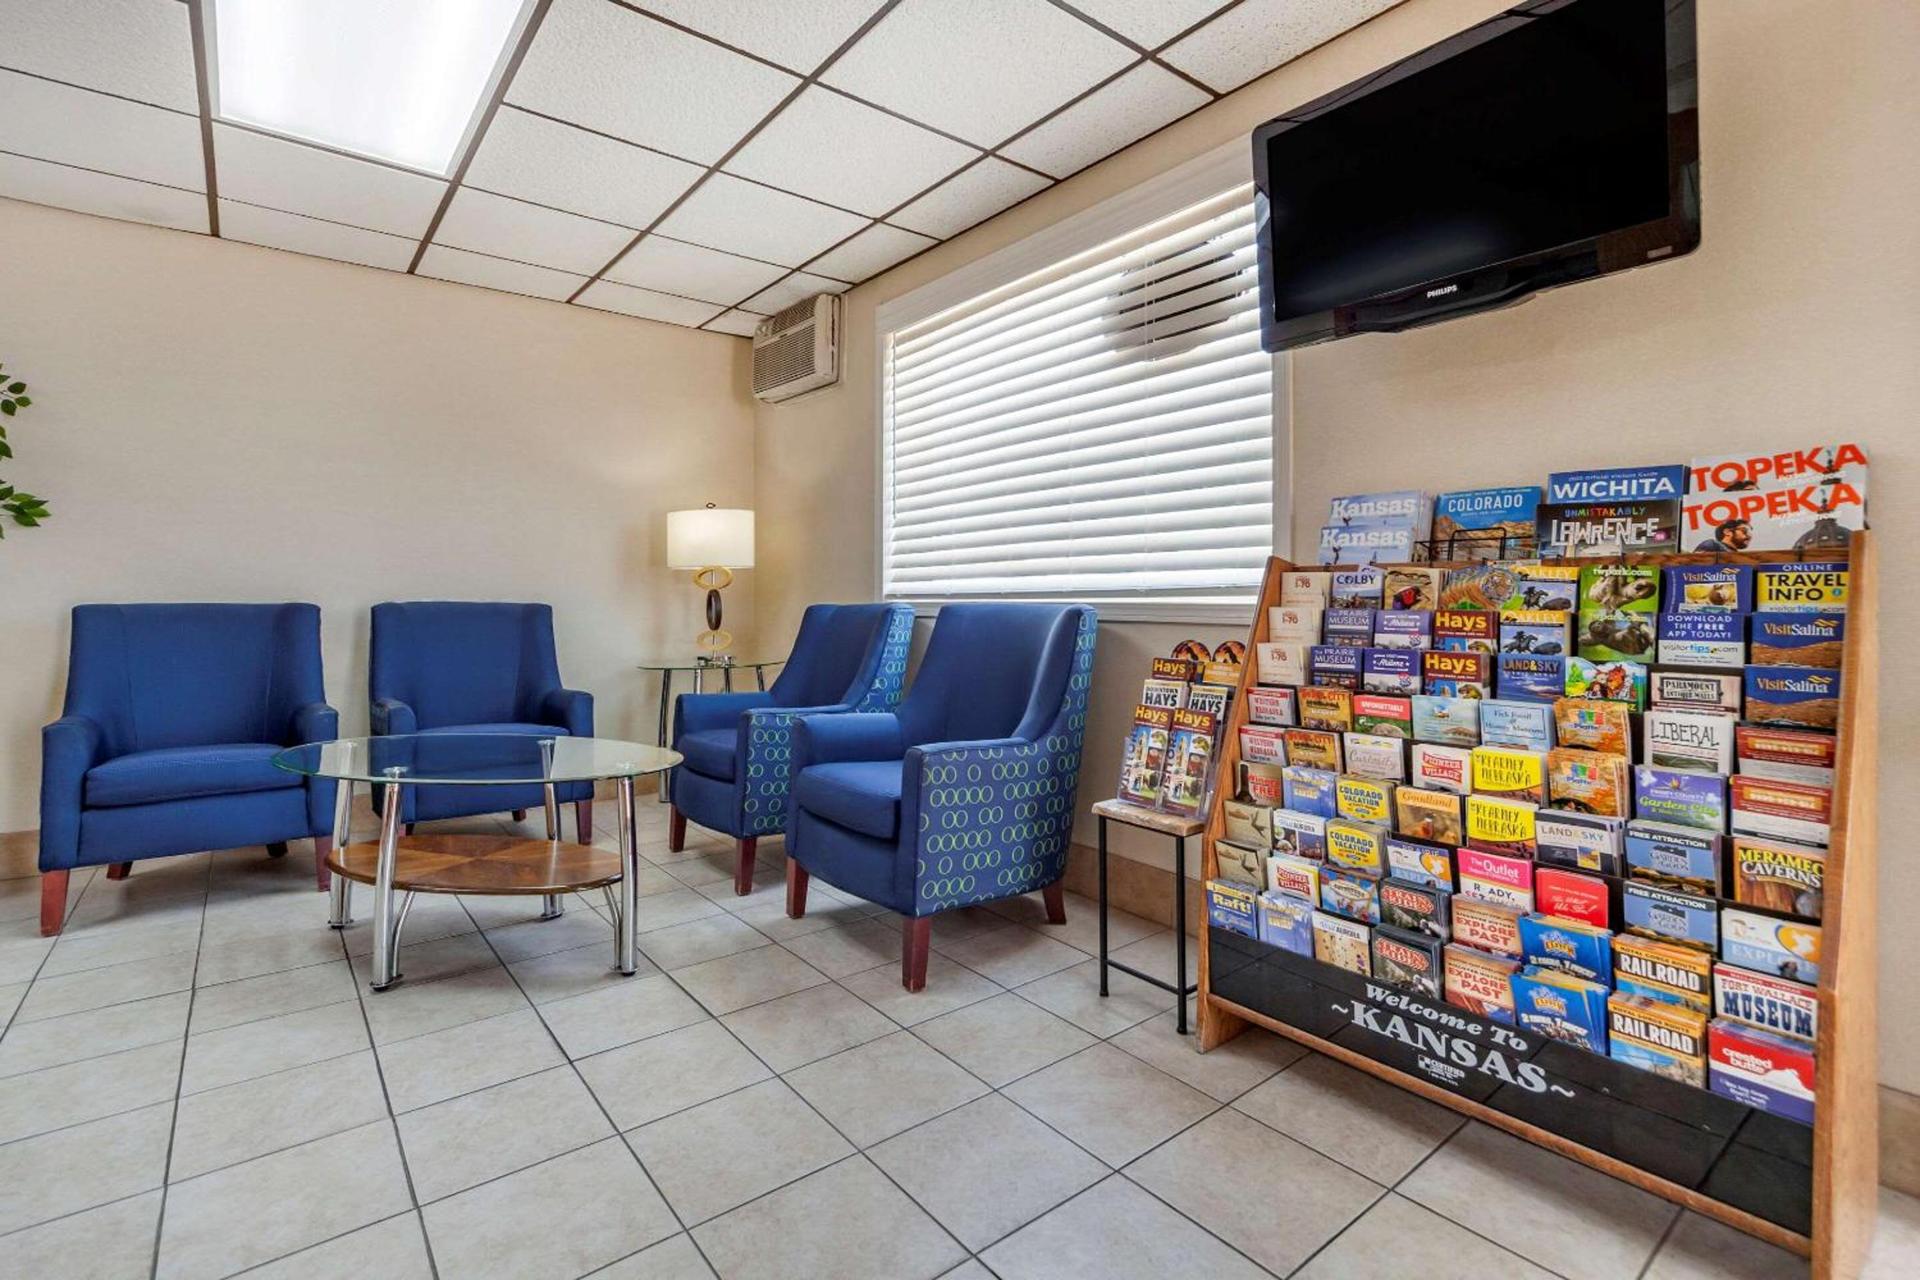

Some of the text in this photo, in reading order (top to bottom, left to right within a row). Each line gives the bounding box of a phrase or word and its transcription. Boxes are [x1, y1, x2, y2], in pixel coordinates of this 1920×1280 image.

[1427, 283, 1458, 299] PHILIPS
[1691, 443, 1868, 493] TOPEKA
[1553, 477, 1676, 499] WICHITA
[1332, 498, 1418, 519] Kansas
[1448, 494, 1524, 513] COLORADO
[1564, 506, 1647, 518] UNMISTAKABLY
[1683, 483, 1862, 530] TOPEKA
[1321, 528, 1409, 549] Kansas
[1551, 518, 1660, 546] LAWRENCE
[1782, 564, 1832, 572] ONLINE
[1336, 574, 1377, 585] COLBY
[1766, 573, 1846, 587] TRAVEL
[1768, 588, 1824, 601] INFO
[1328, 617, 1370, 626] MUSEUM
[1435, 612, 1488, 631] Hays
[1667, 615, 1733, 623] DOWNLOAD
[1697, 623, 1725, 631] FREE
[1667, 630, 1732, 638] APP TODAY!
[1153, 659, 1187, 675] Hays
[1314, 655, 1356, 664] MUSEUM
[1425, 653, 1477, 674] Hays
[1665, 681, 1715, 690] PARAMOUNT
[1144, 692, 1178, 707] HAYS
[1190, 699, 1223, 714] HAYS
[1135, 706, 1169, 723] Hays
[1174, 709, 1211, 727] Hays
[1651, 719, 1720, 747] LIBERAL
[1481, 754, 1524, 770] KEARNEY
[1482, 768, 1531, 786] NEBRASKA
[1339, 786, 1383, 800] COLORADO
[1343, 795, 1380, 807] VACATION
[1475, 803, 1519, 820] KEARNEY
[1640, 796, 1687, 811] Garden
[1476, 817, 1526, 838] NEBRASKA
[1541, 826, 1573, 836] LAND
[1581, 830, 1604, 841] SKY
[1330, 832, 1373, 847] COLORADO
[1334, 841, 1370, 854] VACATION
[1629, 830, 1707, 848] FREE ATTRACTION
[1483, 859, 1519, 879] Outlet
[1739, 848, 1823, 878] MERAMEC
[1741, 861, 1822, 888] CAVERNS
[1213, 893, 1251, 914] Raft!
[1628, 887, 1706, 910] FREE ATTRACTION
[1456, 916, 1517, 938] EXPLORE
[1470, 928, 1511, 946] PAST
[1449, 967, 1508, 991] EXPLORE
[1620, 953, 1701, 991] RAILROAD
[1461, 980, 1503, 999] PAST
[1721, 978, 1749, 993] FORT
[1751, 985, 1813, 1011] WALLACE
[1365, 983, 1528, 1051] Welcome To
[1723, 991, 1813, 1037] MUSEUM
[1613, 1014, 1693, 1054] RAILROAD
